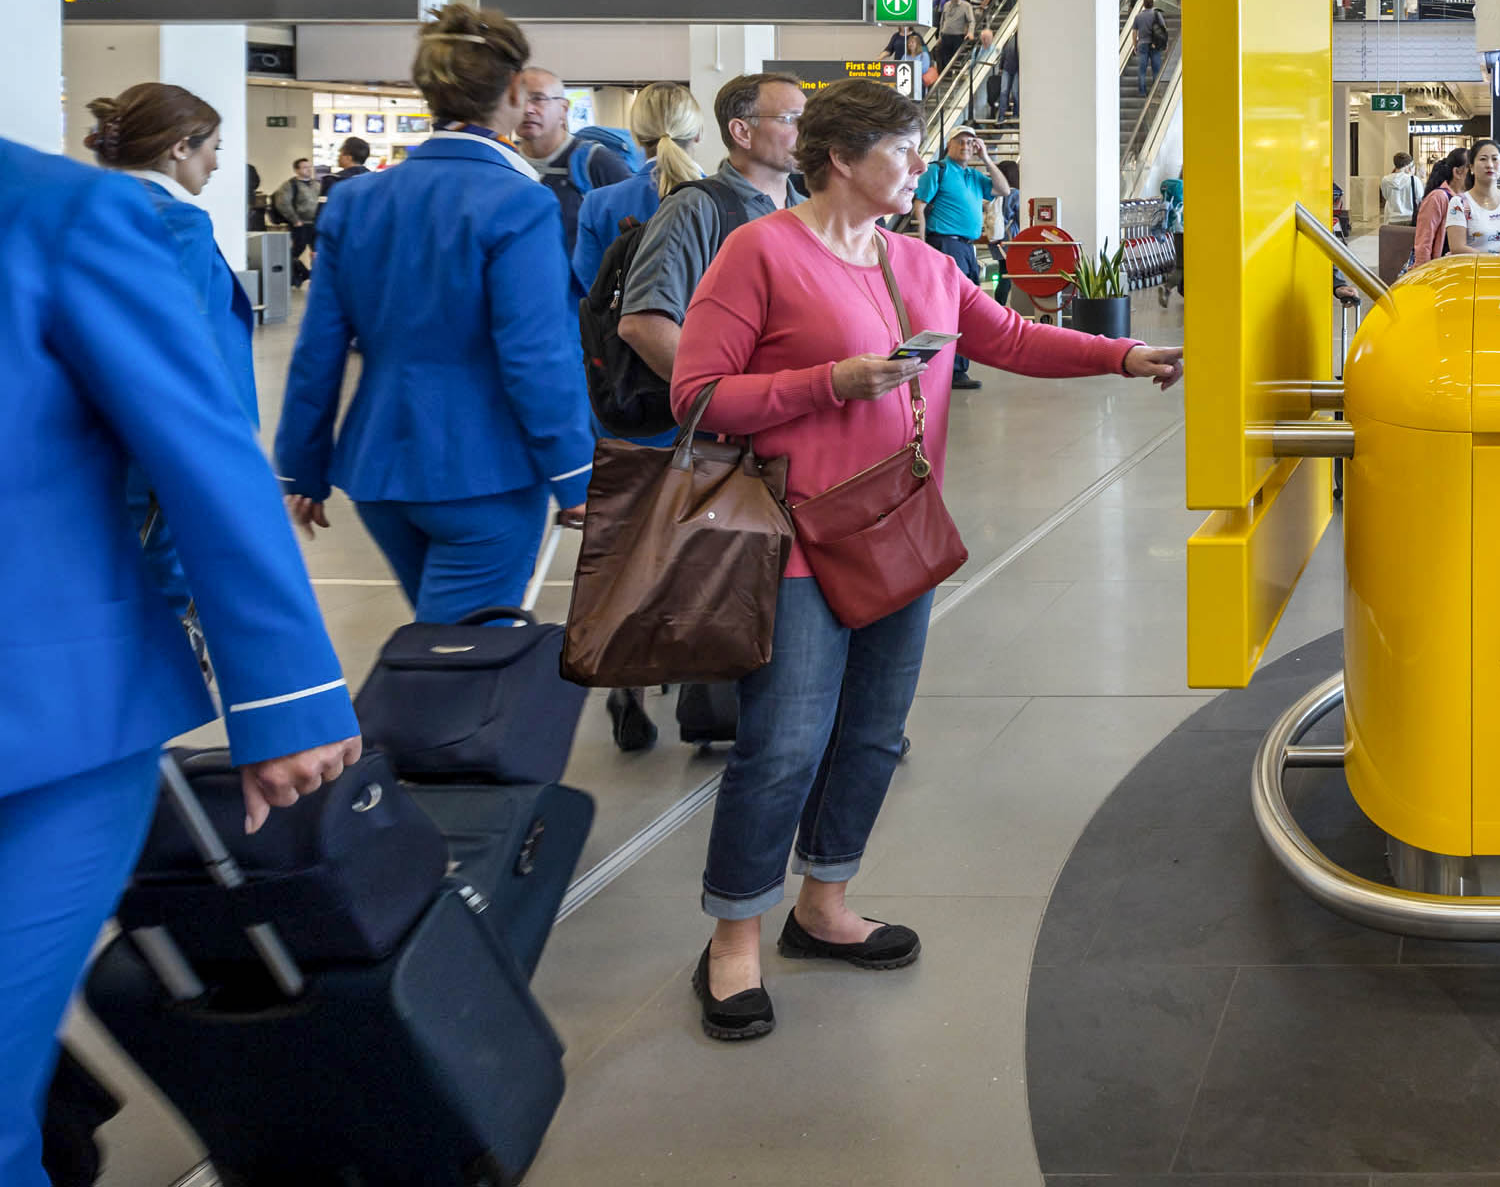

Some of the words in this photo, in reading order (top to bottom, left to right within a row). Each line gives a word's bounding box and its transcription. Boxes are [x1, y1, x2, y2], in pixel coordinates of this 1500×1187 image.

[845, 62, 865, 70] First
[867, 62, 881, 70] aid
[1408, 124, 1463, 133] URBERRY
